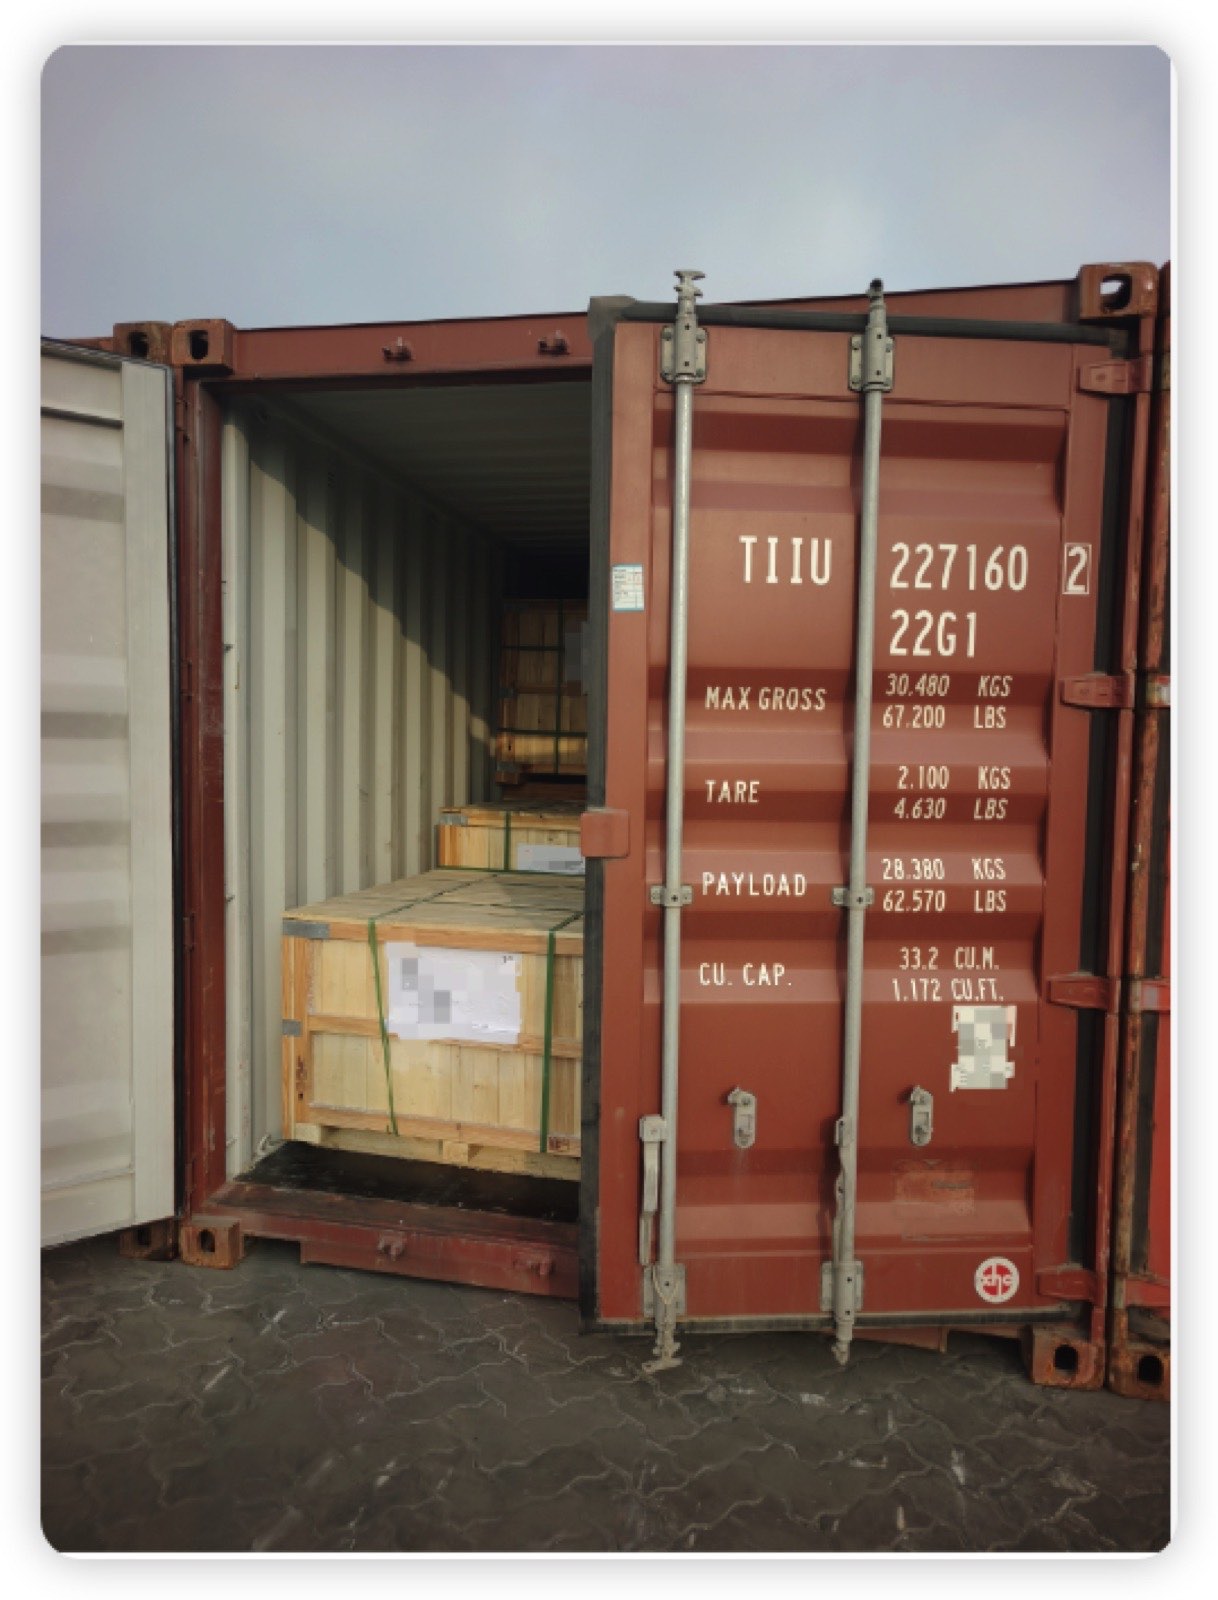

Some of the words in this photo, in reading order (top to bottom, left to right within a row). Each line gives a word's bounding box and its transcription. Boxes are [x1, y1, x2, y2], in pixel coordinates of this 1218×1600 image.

[740, 535, 832, 586] TIIU
[890, 541, 1028, 591] 227160
[1065, 546, 1090, 593] 2
[889, 608, 977, 658] 22G1
[885, 673, 950, 698] 30.480
[977, 674, 1013, 698] KGS
[704, 686, 751, 711] MAX
[758, 686, 827, 712] GROSS
[882, 704, 946, 729] 67.200
[973, 704, 1006, 729] LBS
[898, 765, 950, 790] 2.100
[978, 765, 1010, 790] KGS
[705, 778, 760, 804] TARE
[894, 797, 946, 819] 4.630
[972, 797, 1009, 820] LBS
[882, 858, 945, 880] 28.380
[972, 858, 1006, 881] KGS
[702, 871, 806, 897] PAYLOAD
[882, 889, 946, 912] 62.570
[975, 889, 1006, 912] LBS
[899, 946, 940, 971] 33.2
[742, 962, 792, 986] CAP.
[892, 978, 942, 1003] 1.172
